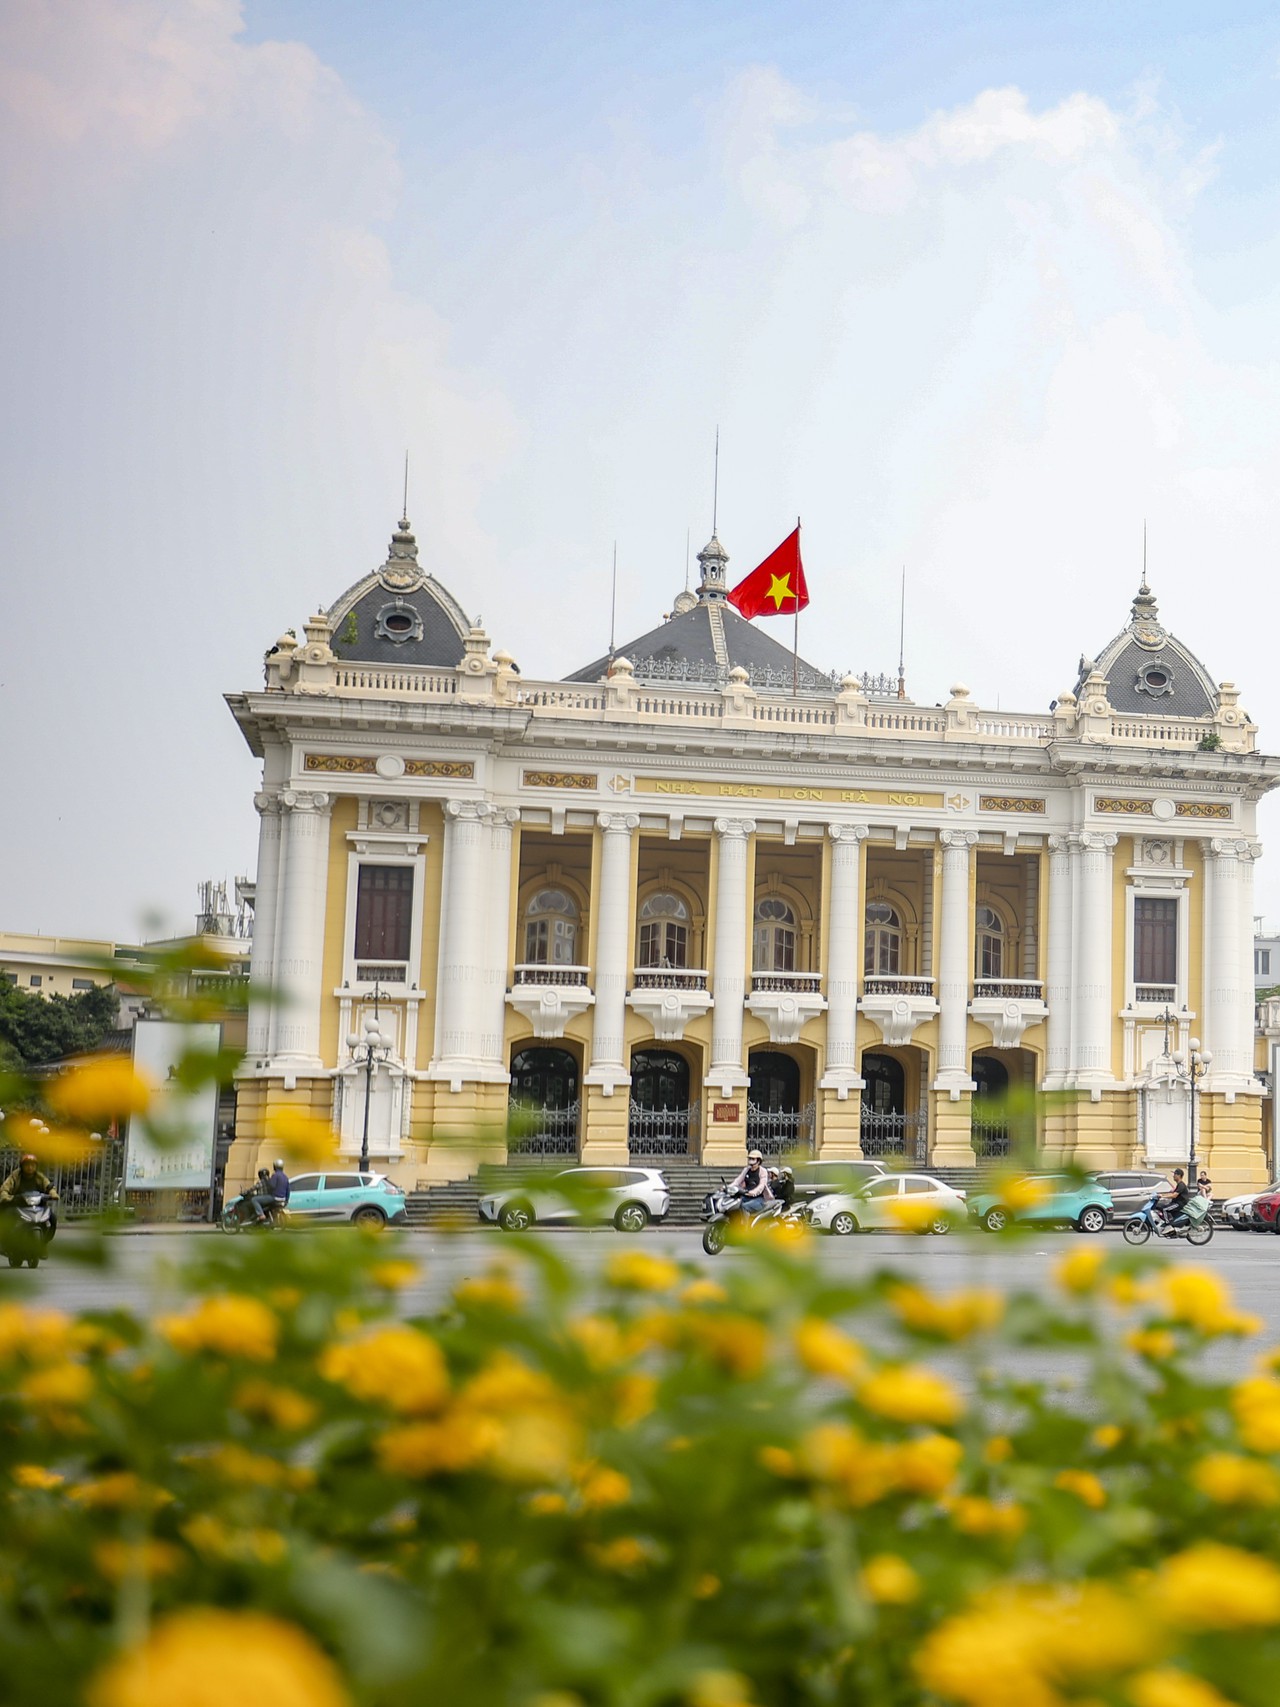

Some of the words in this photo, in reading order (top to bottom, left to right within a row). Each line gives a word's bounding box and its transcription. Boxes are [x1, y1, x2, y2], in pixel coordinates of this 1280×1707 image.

[655, 780, 701, 794] NHÀ
[719, 784, 762, 797] HÁT
[779, 787, 824, 801] LỚN
[840, 790, 870, 803] HÀ
[888, 793, 924, 806] NỘI
